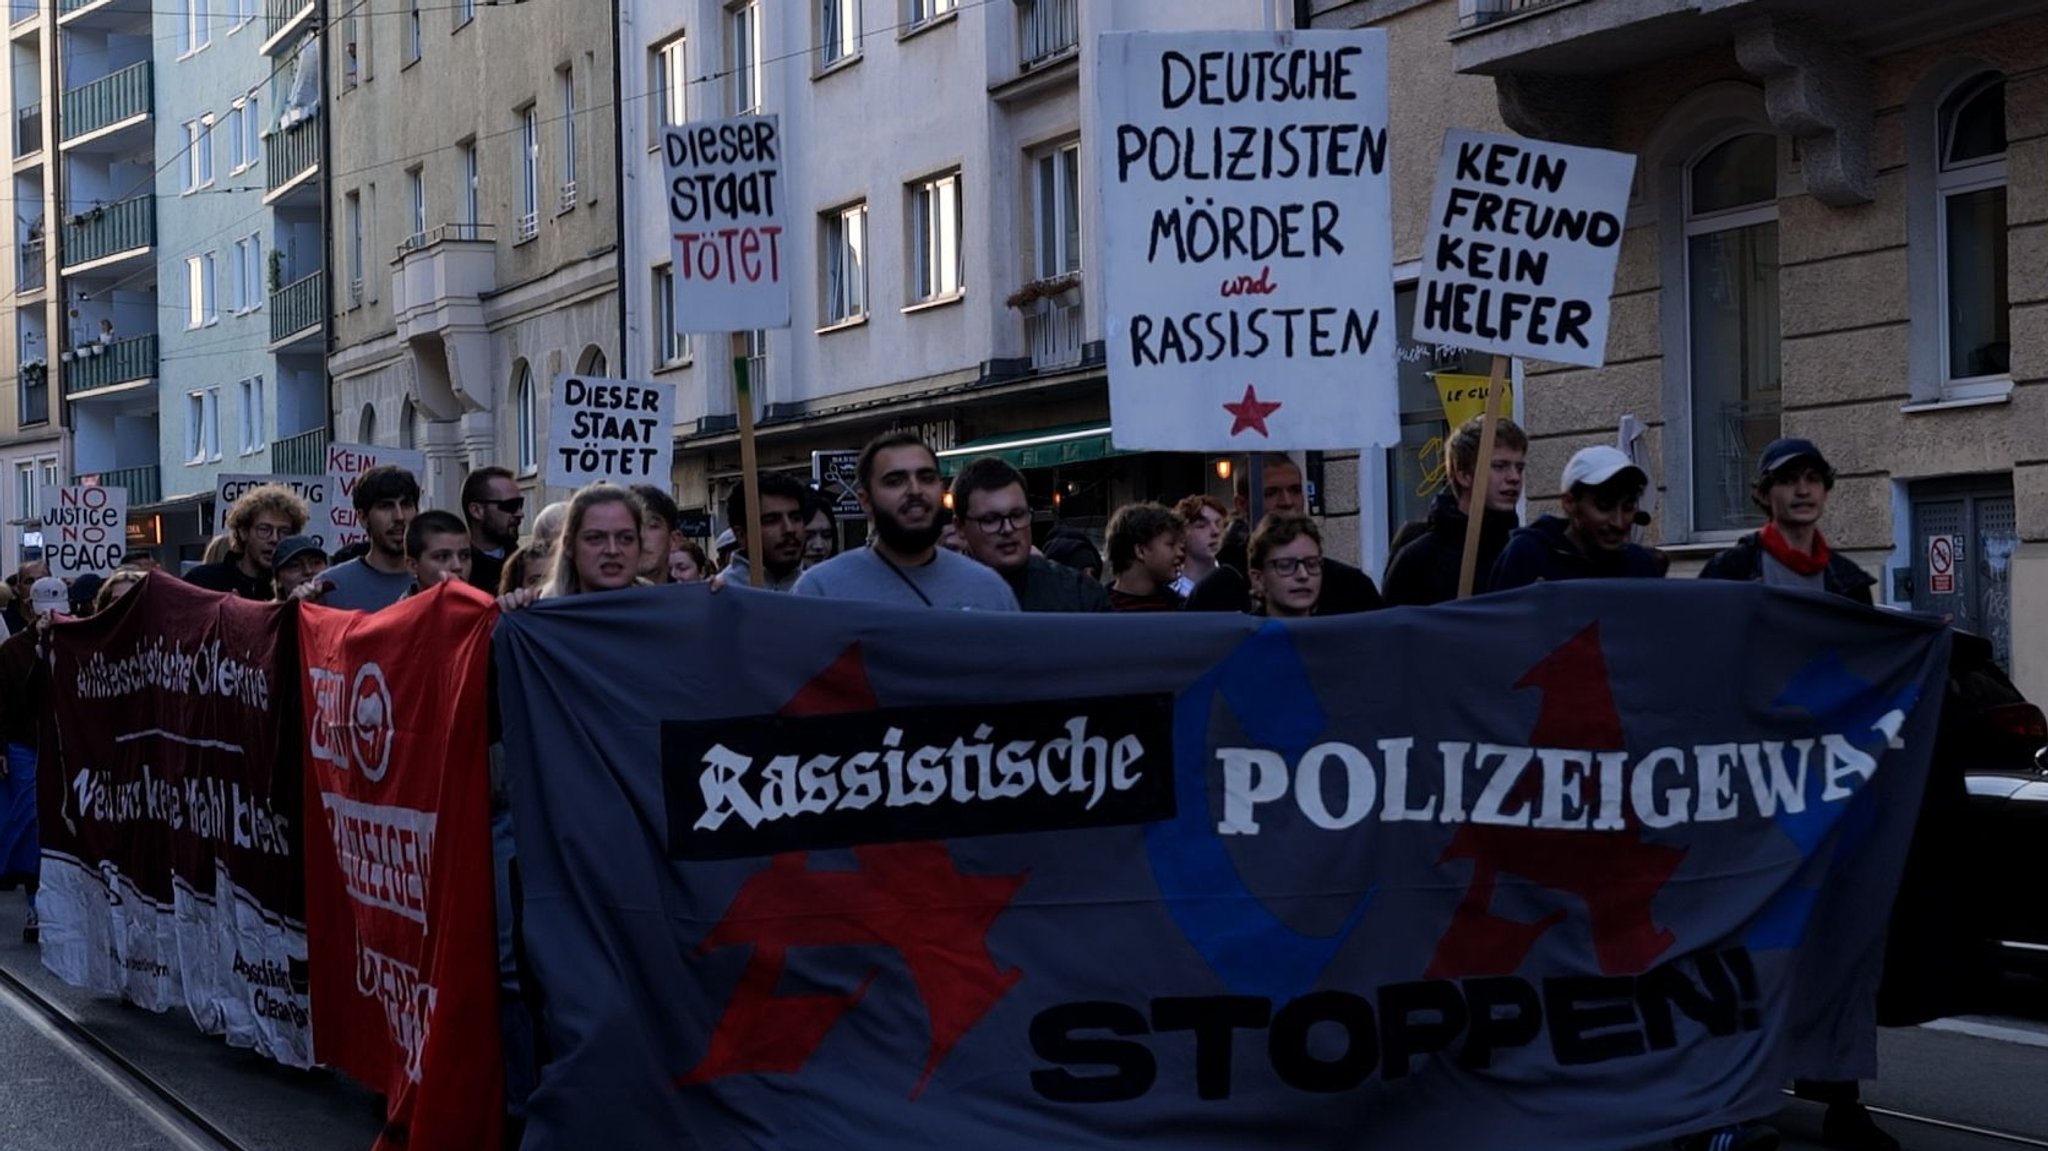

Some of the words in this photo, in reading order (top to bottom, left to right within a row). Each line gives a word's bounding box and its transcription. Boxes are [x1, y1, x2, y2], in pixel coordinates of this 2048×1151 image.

[1162, 47, 1362, 108] DEUTSCHE
[1117, 123, 1387, 182] POLIZISTEN
[1456, 141, 1567, 193] KEIN
[1148, 195, 1345, 264] MÖRDER
[1443, 187, 1621, 248] FREUND
[1221, 266, 1278, 297] und
[1436, 233, 1549, 286] KEIN
[1130, 308, 1380, 367] RASSISTEN
[1423, 280, 1593, 349] HELFER
[565, 378, 660, 413] DIESER
[570, 411, 658, 443] STAAT
[330, 447, 376, 473] KEIN
[558, 441, 659, 476] TÖTET
[61, 487, 108, 509] NO
[222, 480, 324, 503] GETIG
[63, 527, 106, 544] NO
[693, 715, 1145, 831] Rassistische
[1029, 948, 1760, 1101] STOPPEN!
